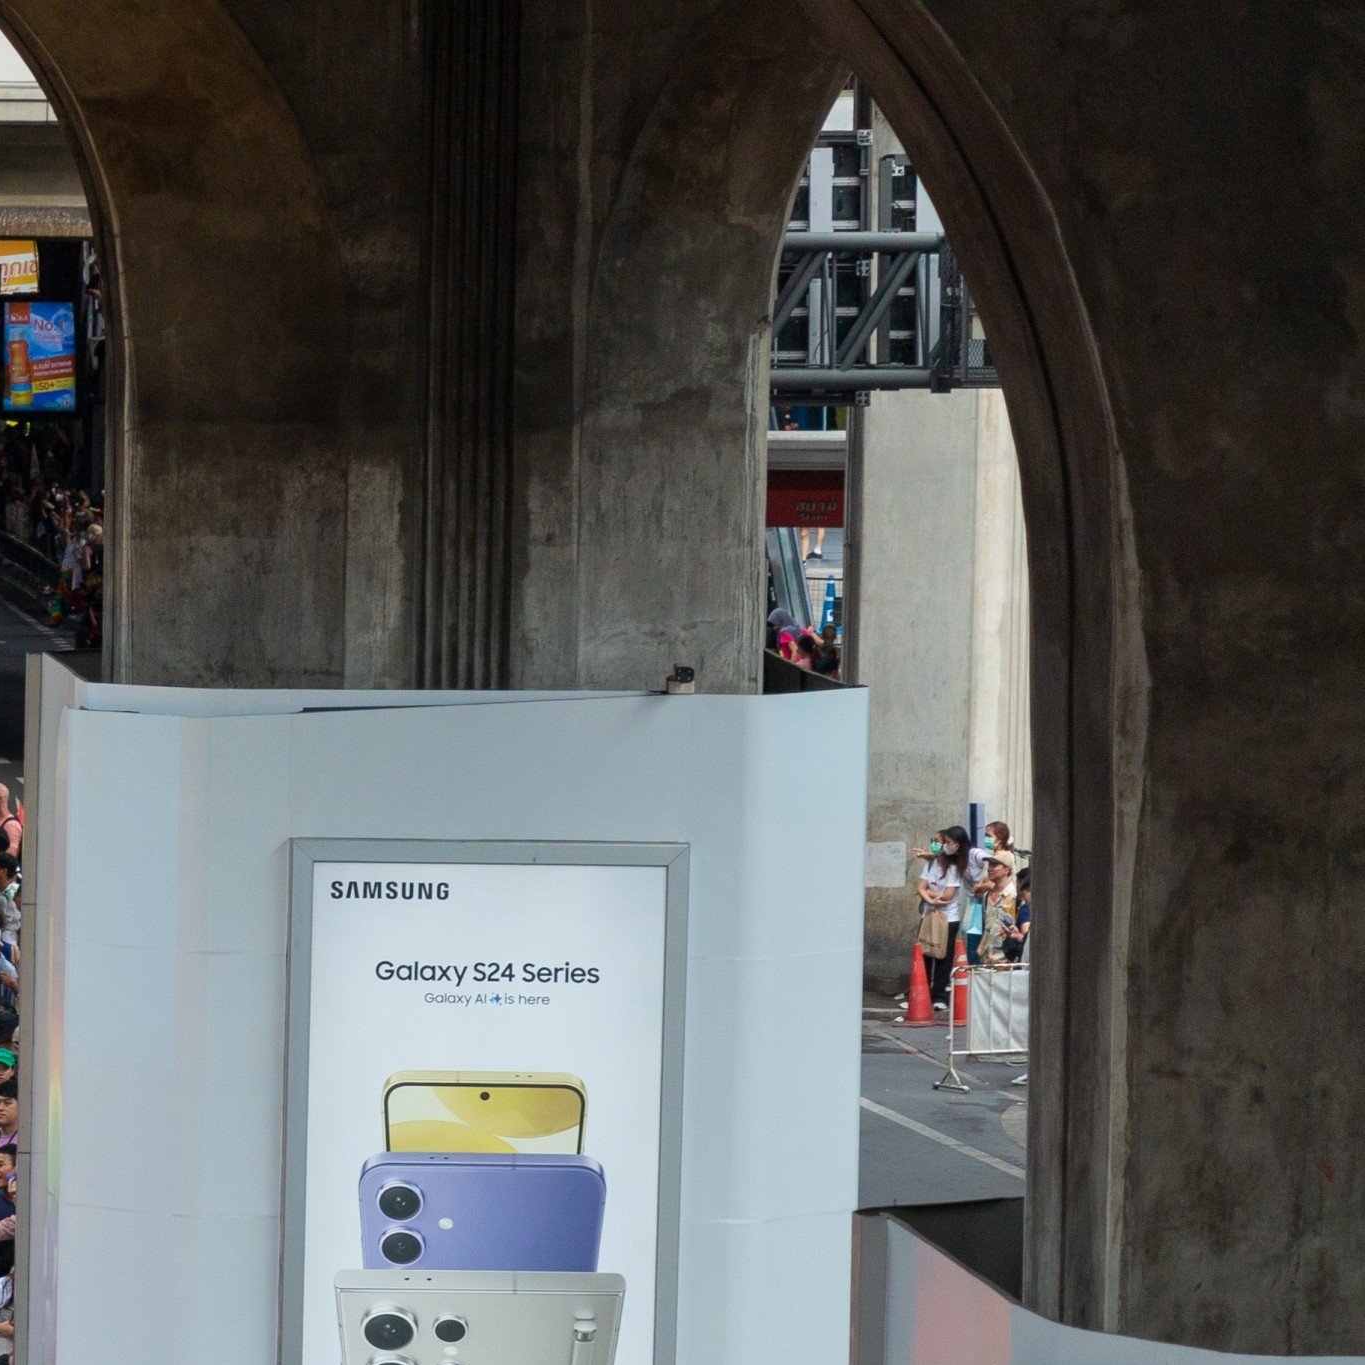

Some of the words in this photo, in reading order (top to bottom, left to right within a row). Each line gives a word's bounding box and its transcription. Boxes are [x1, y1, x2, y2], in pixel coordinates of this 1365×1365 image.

[330, 881, 449, 900] SAMSUNG
[375, 961, 467, 986] Galaxy
[473, 962, 515, 983] S24
[522, 962, 600, 984] Series
[424, 992, 472, 1007] Galaxy
[475, 993, 487, 1004] AI
[504, 993, 514, 1004] is
[518, 993, 550, 1005] here
